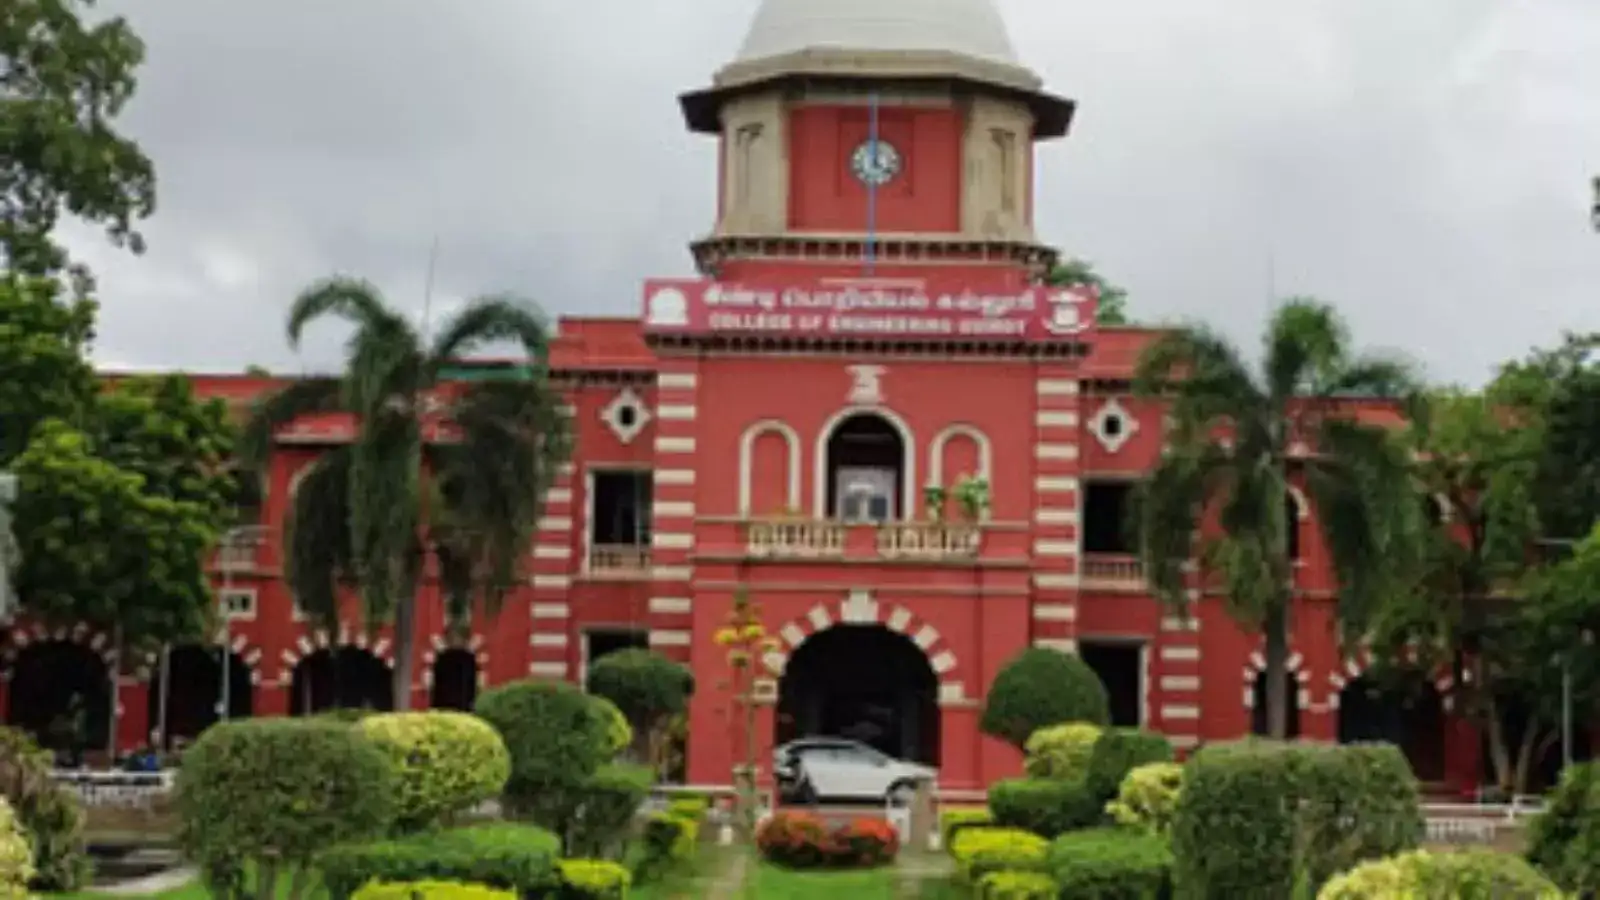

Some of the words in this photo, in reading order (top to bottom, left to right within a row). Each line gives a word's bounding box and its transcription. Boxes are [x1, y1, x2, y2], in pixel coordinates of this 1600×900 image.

[708, 313, 792, 330] COLLEGE
[798, 314, 822, 330] OF
[828, 315, 952, 333] ENGINEERING
